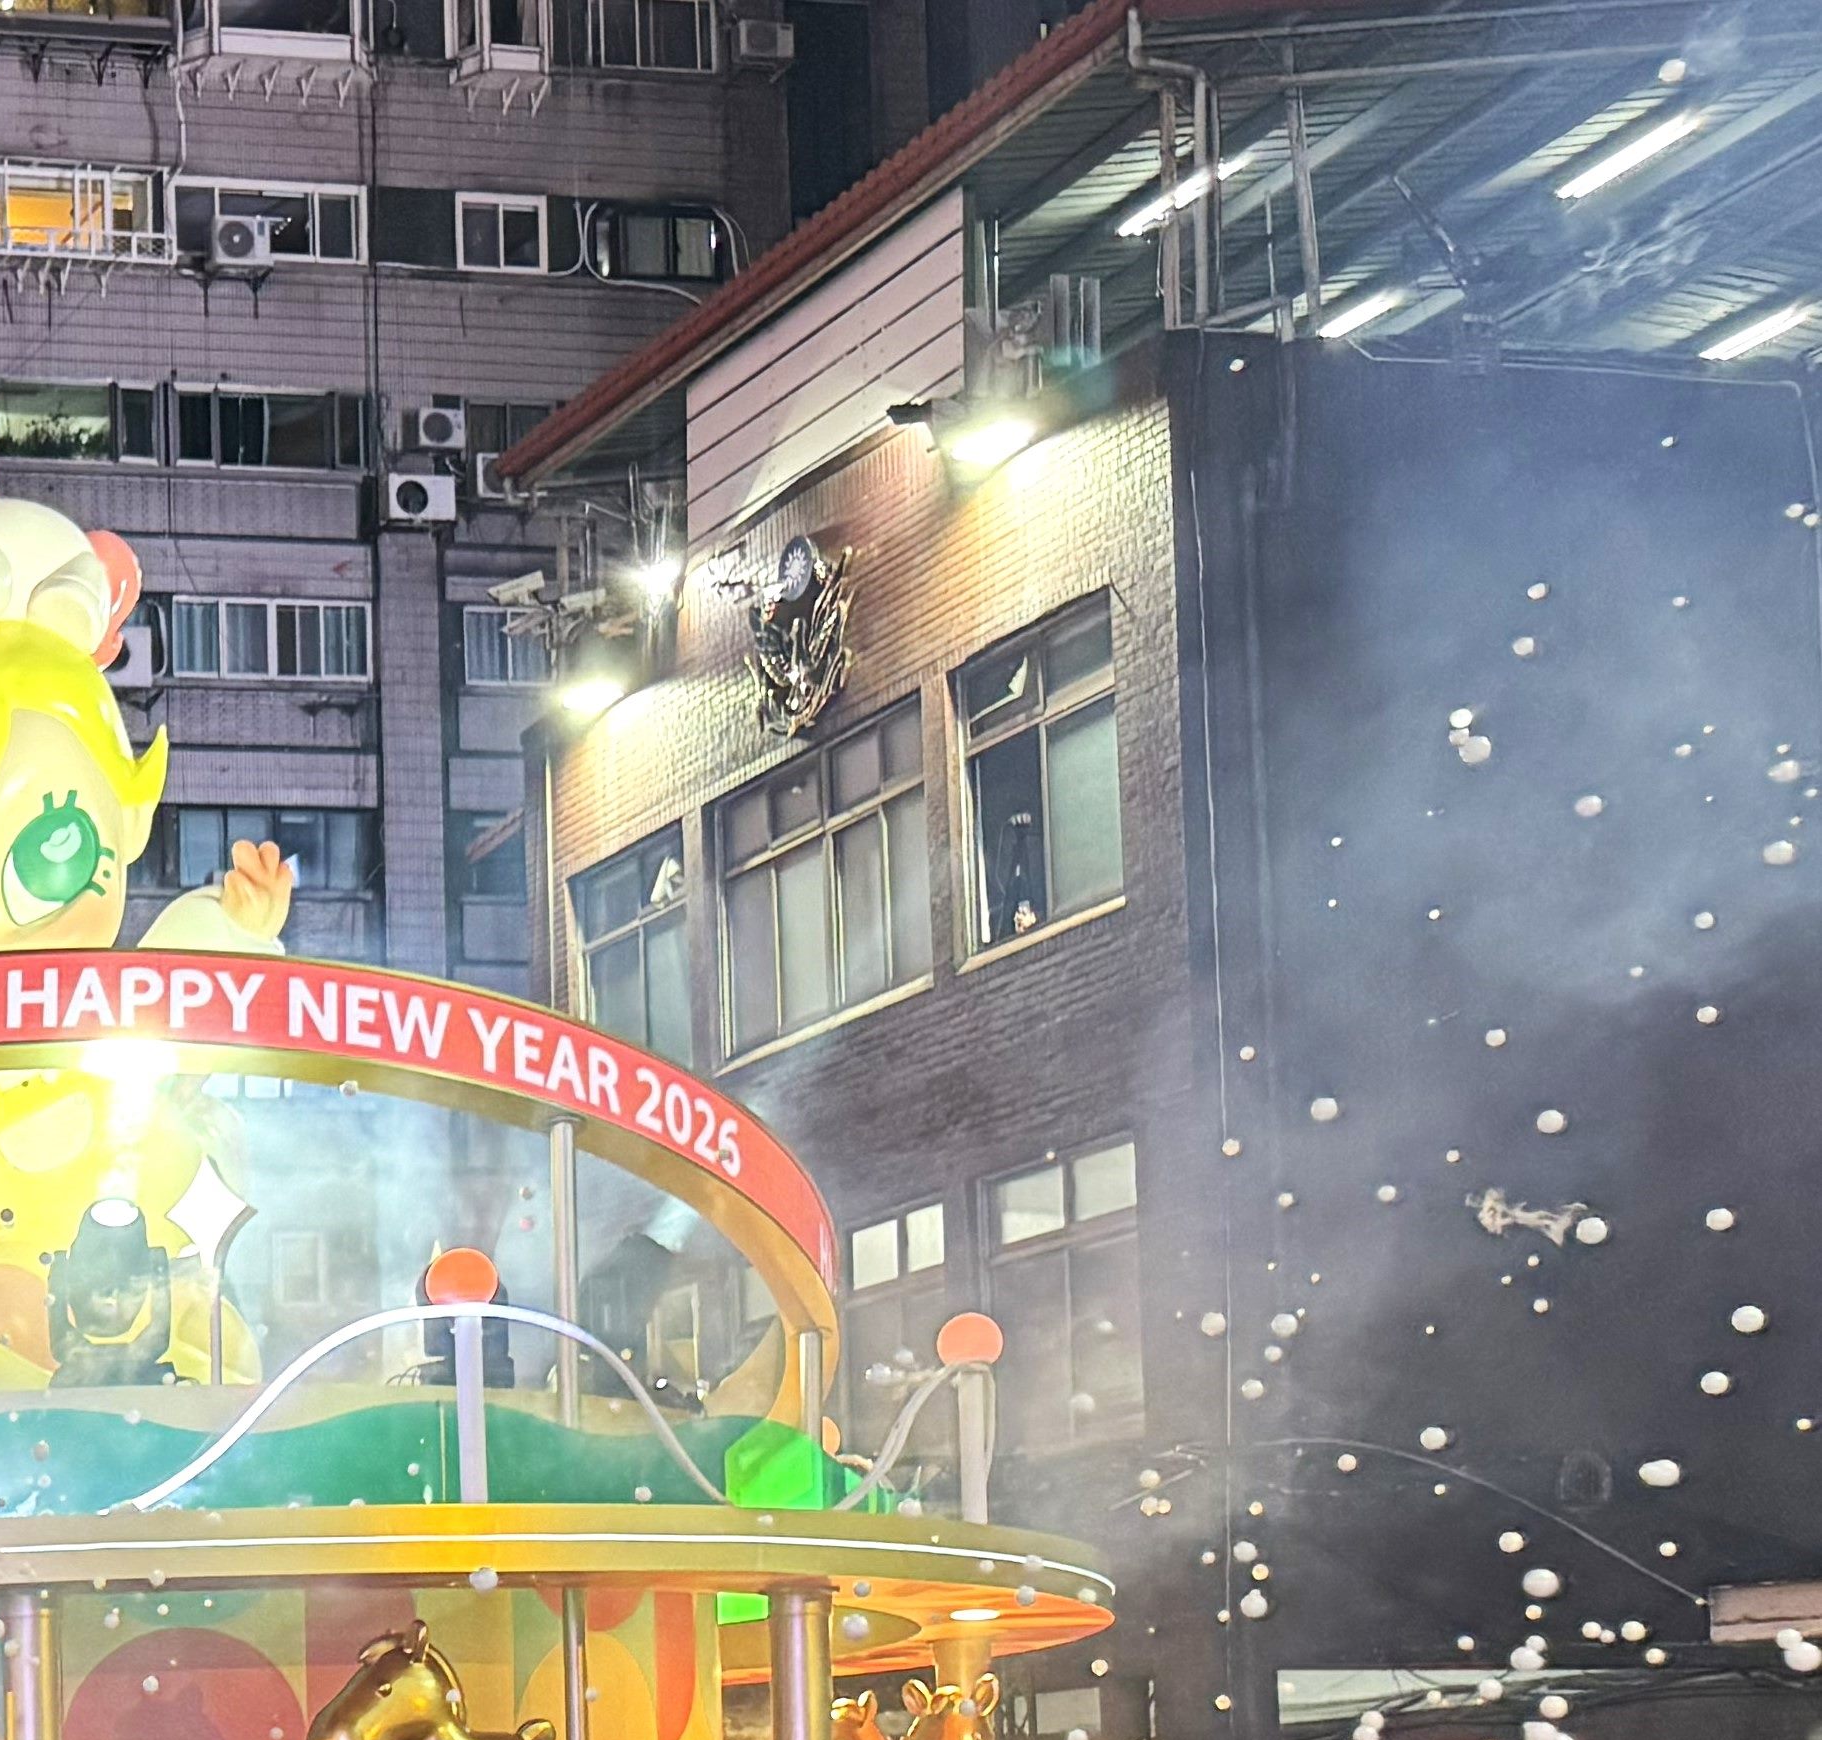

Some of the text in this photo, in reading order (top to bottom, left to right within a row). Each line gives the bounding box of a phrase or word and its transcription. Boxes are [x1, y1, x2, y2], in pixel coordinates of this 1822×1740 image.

[5, 966, 742, 1180] HAPPY NEW YEAR 2026
